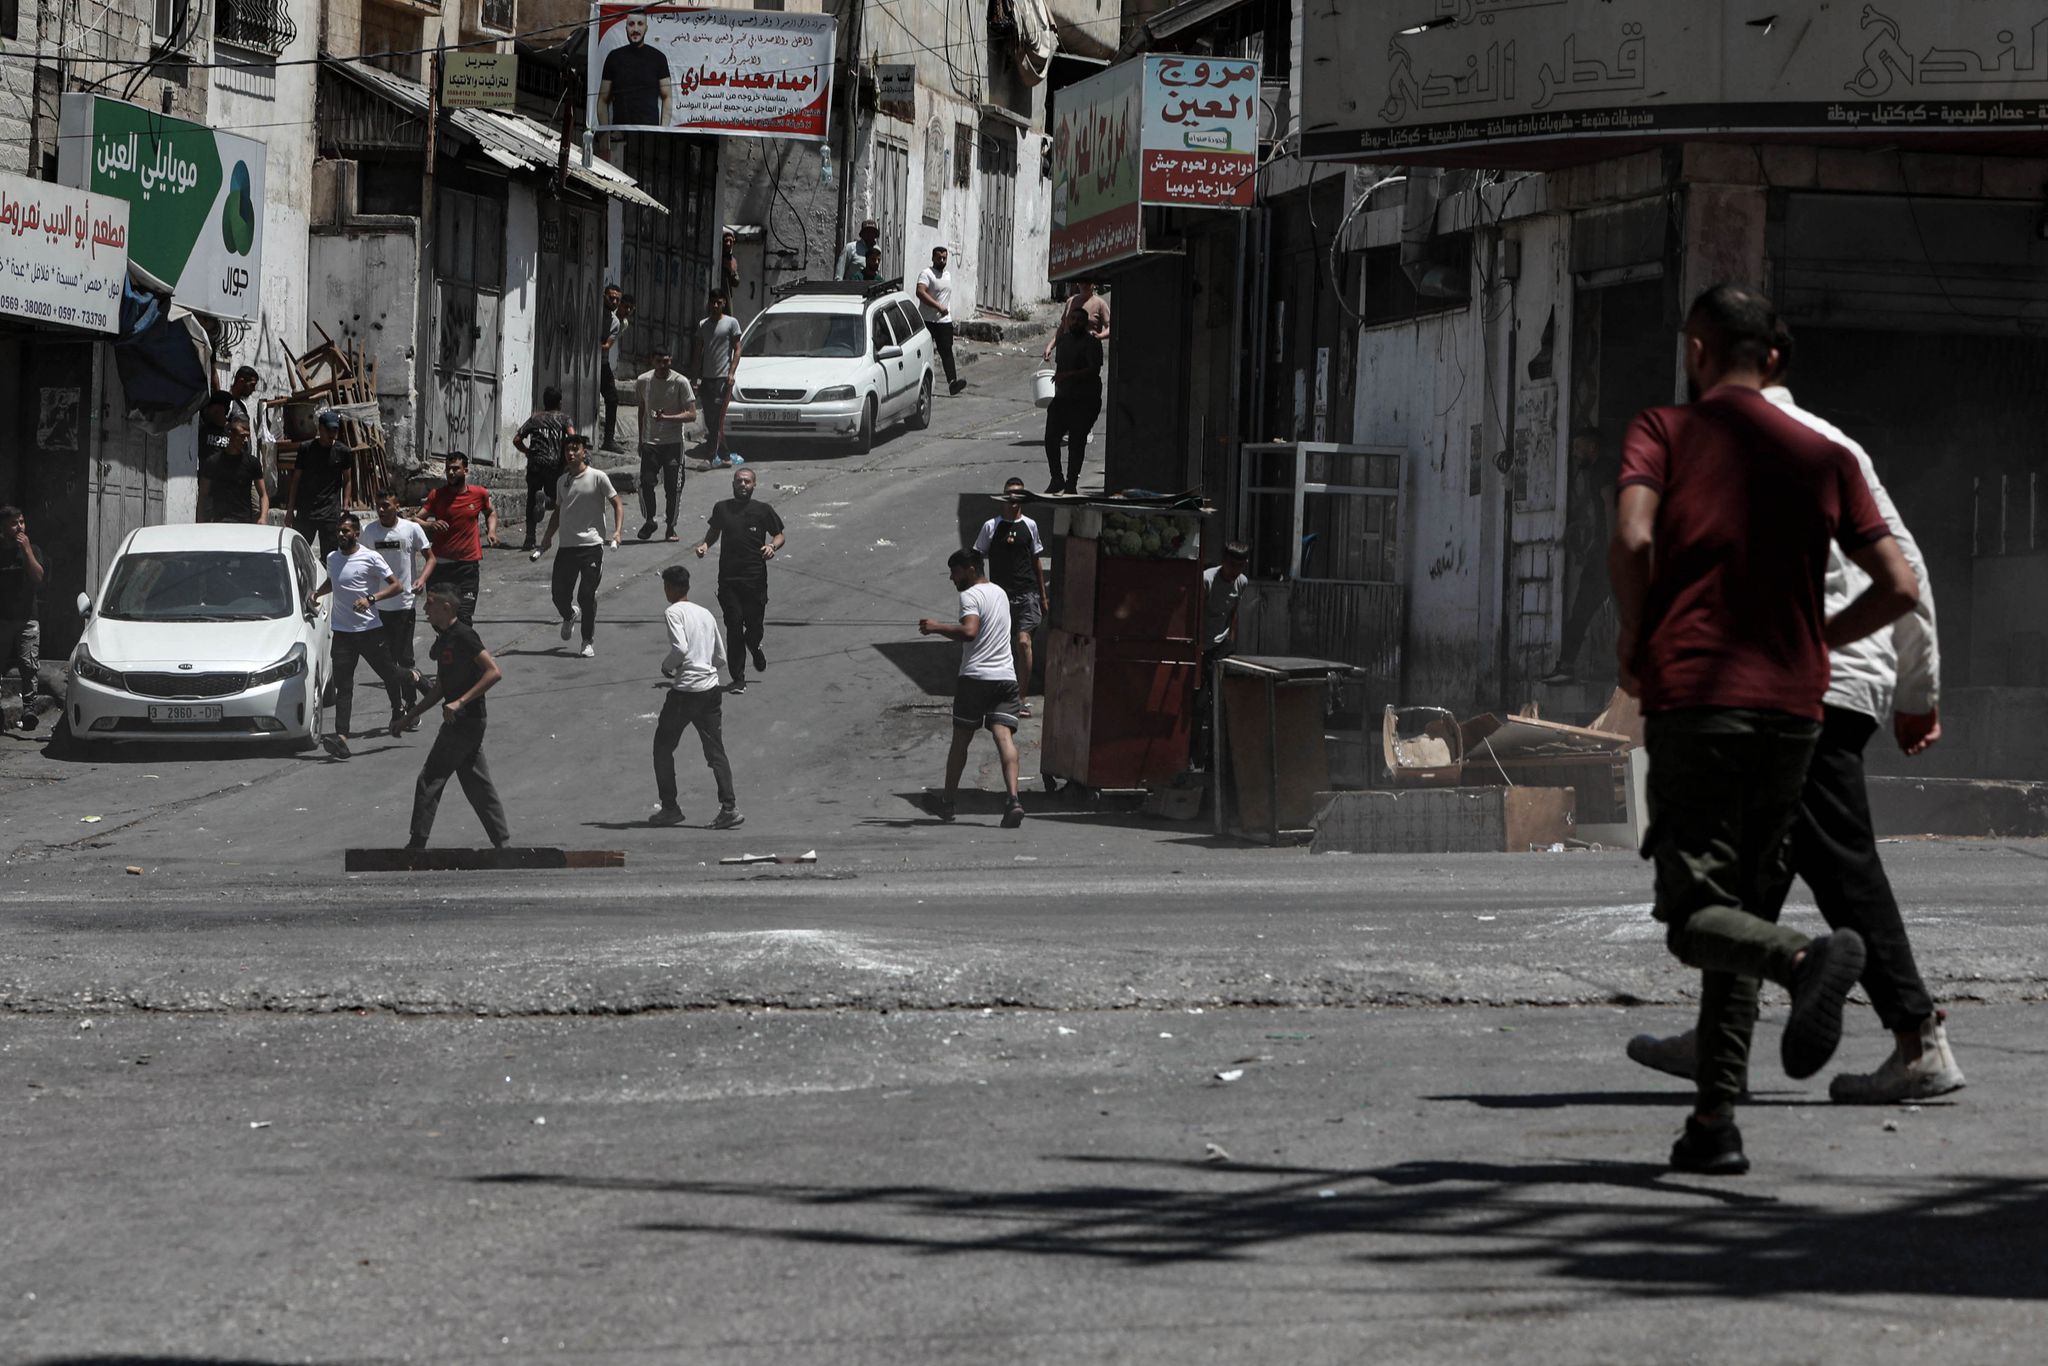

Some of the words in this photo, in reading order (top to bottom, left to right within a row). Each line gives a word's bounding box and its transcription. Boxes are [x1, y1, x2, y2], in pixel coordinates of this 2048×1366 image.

[465, 56, 498, 70] جبريل
[1159, 58, 1256, 90] مروج
[728, 67, 776, 91] محمد
[1161, 90, 1253, 127] العين
[1871, 104, 1927, 125] كوكتيل
[96, 131, 138, 182] العين
[1150, 153, 1179, 174] حبش
[1181, 157, 1208, 174] لحوم
[1219, 159, 1253, 177] دواجن
[141, 140, 198, 201] موبايلي
[1197, 179, 1238, 198] طازجة
[43, 204, 73, 245] الديب
[75, 199, 90, 249] أبو
[91, 215, 125, 261] مطعم
[10, 257, 25, 282] عجة
[31, 261, 51, 284] فلافل
[222, 264, 250, 297] جوال
[84, 281, 103, 294] حمص
[107, 280, 120, 300] فول
